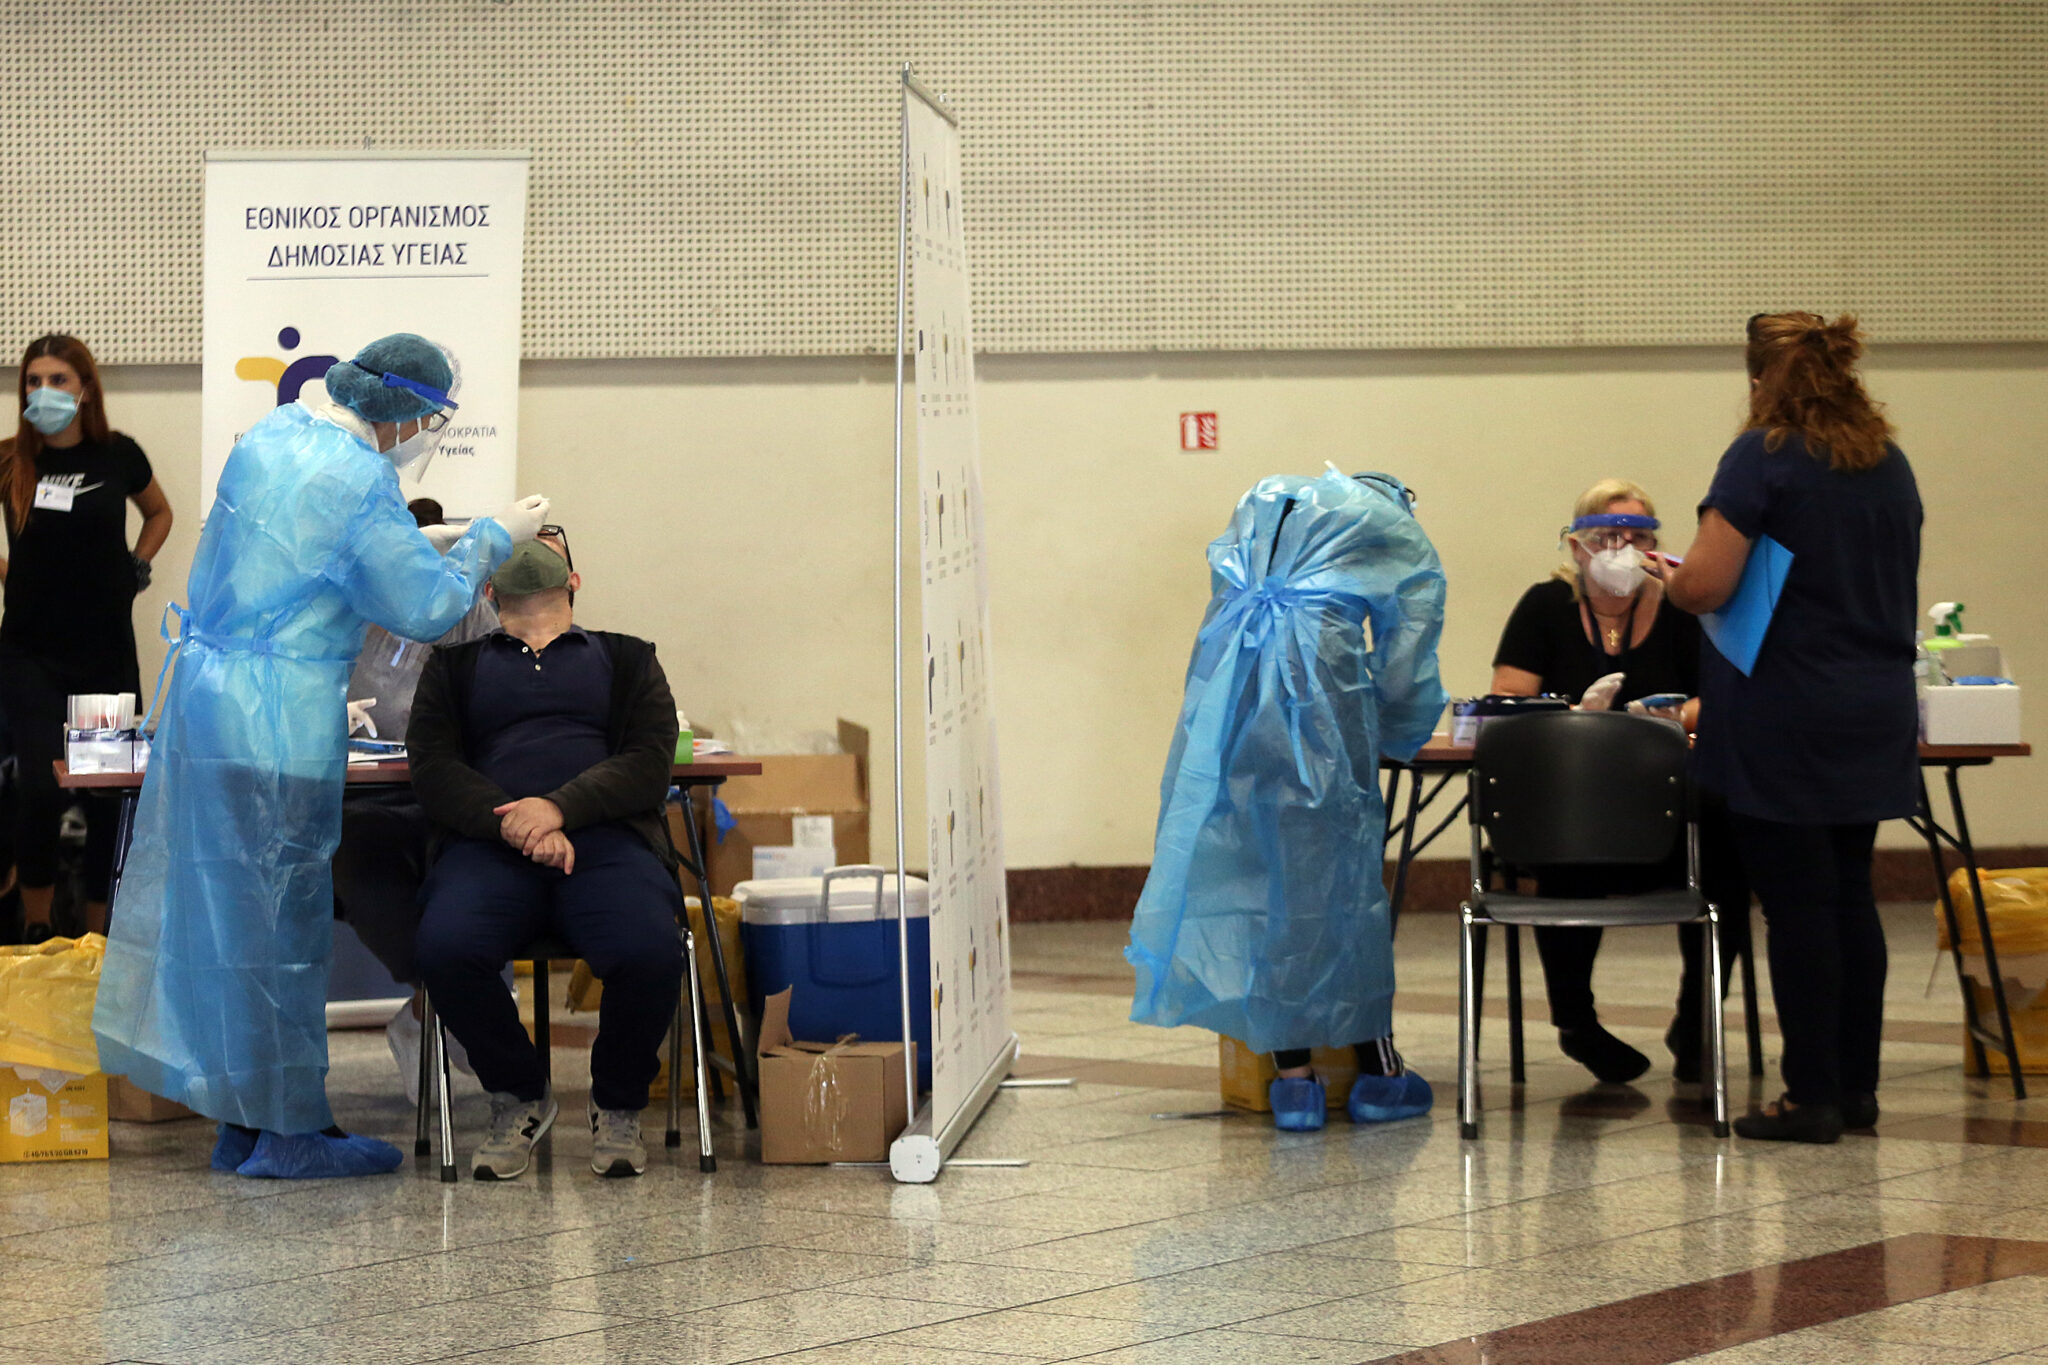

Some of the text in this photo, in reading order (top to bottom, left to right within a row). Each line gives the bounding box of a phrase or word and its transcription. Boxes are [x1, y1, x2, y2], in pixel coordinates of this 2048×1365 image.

[246, 205, 490, 229] ΕΘΝΙΚΟΣ ΟΡΓΑΝΙΣΜΟΣ
[267, 243, 467, 267] ΔΗΜΟΣΙΑΣ ΥΓΕΙΑΣ
[443, 426, 497, 438] ΟΚΡΑΤΙΑ
[439, 444, 474, 458] Υγείας
